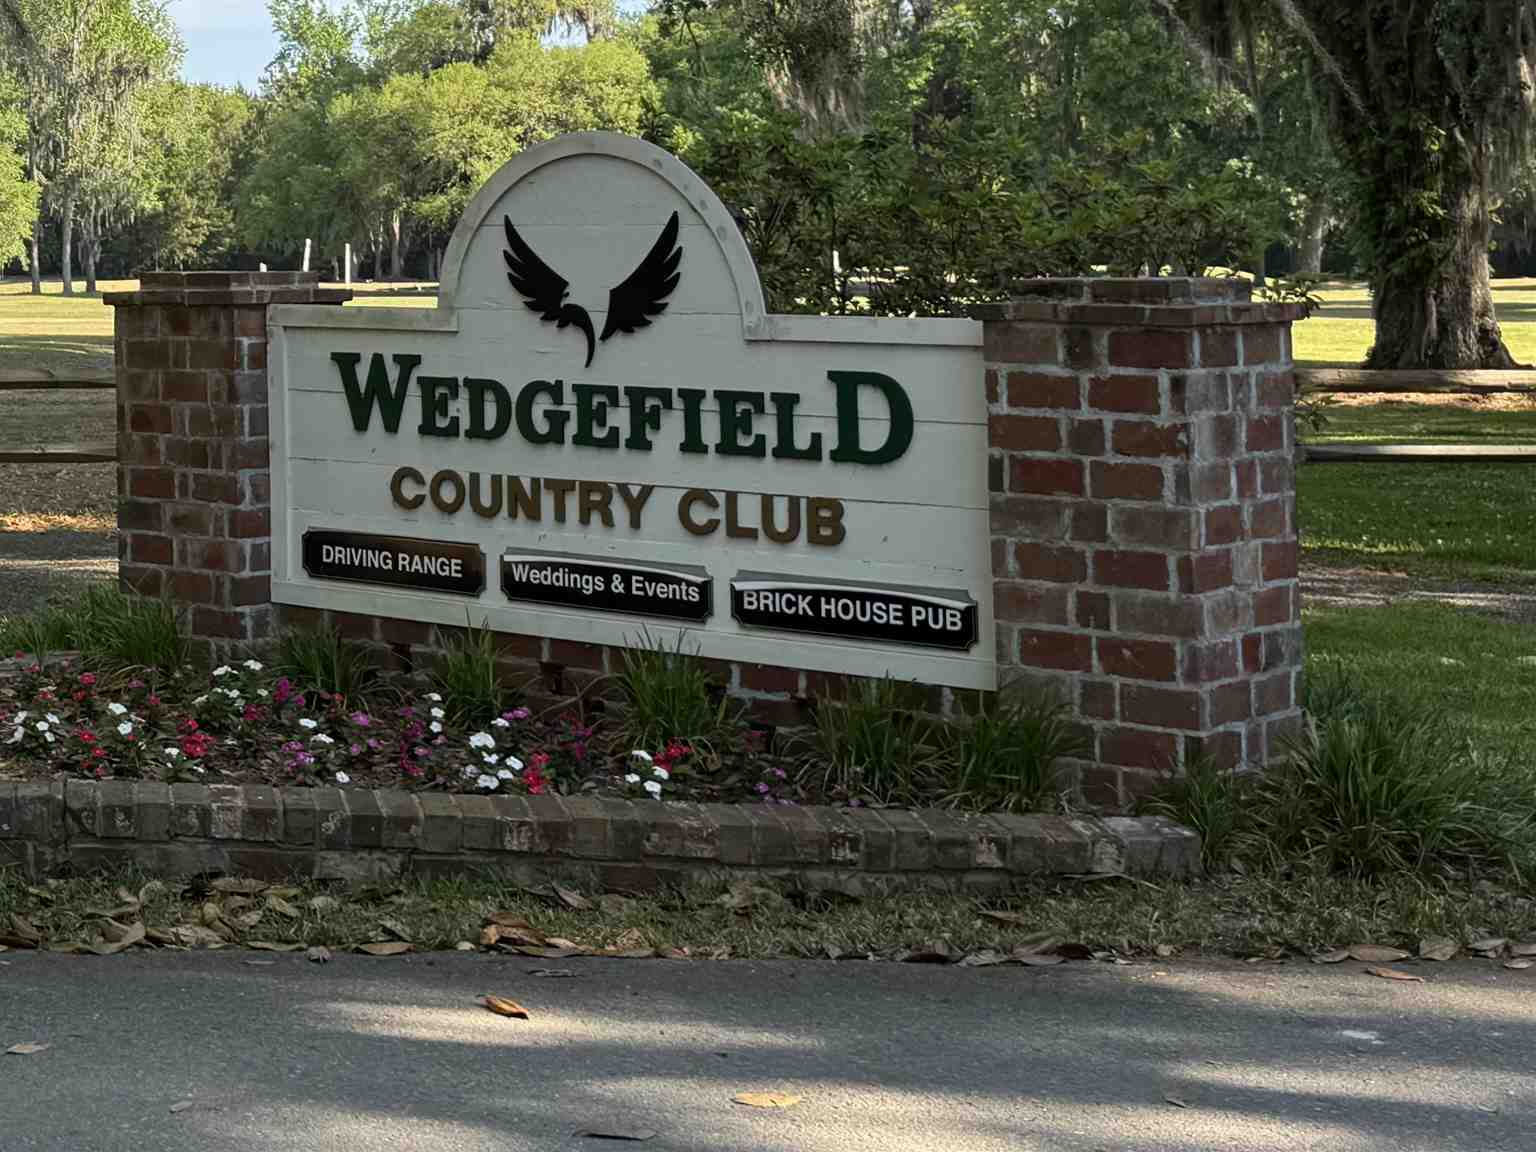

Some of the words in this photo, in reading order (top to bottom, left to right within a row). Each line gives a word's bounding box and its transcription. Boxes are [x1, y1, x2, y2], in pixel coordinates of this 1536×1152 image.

[330, 351, 914, 465] WEDGEFIELD
[390, 466, 655, 531] COUNTRY
[678, 488, 847, 545] CLUB
[321, 545, 393, 571] DRIVING
[397, 554, 463, 578] RANGE
[511, 563, 606, 594] Weddings
[610, 574, 626, 594] &
[630, 575, 700, 603] Events
[742, 589, 814, 618] BRICK
[819, 597, 905, 627] HOUSE
[911, 607, 963, 632] PUB
